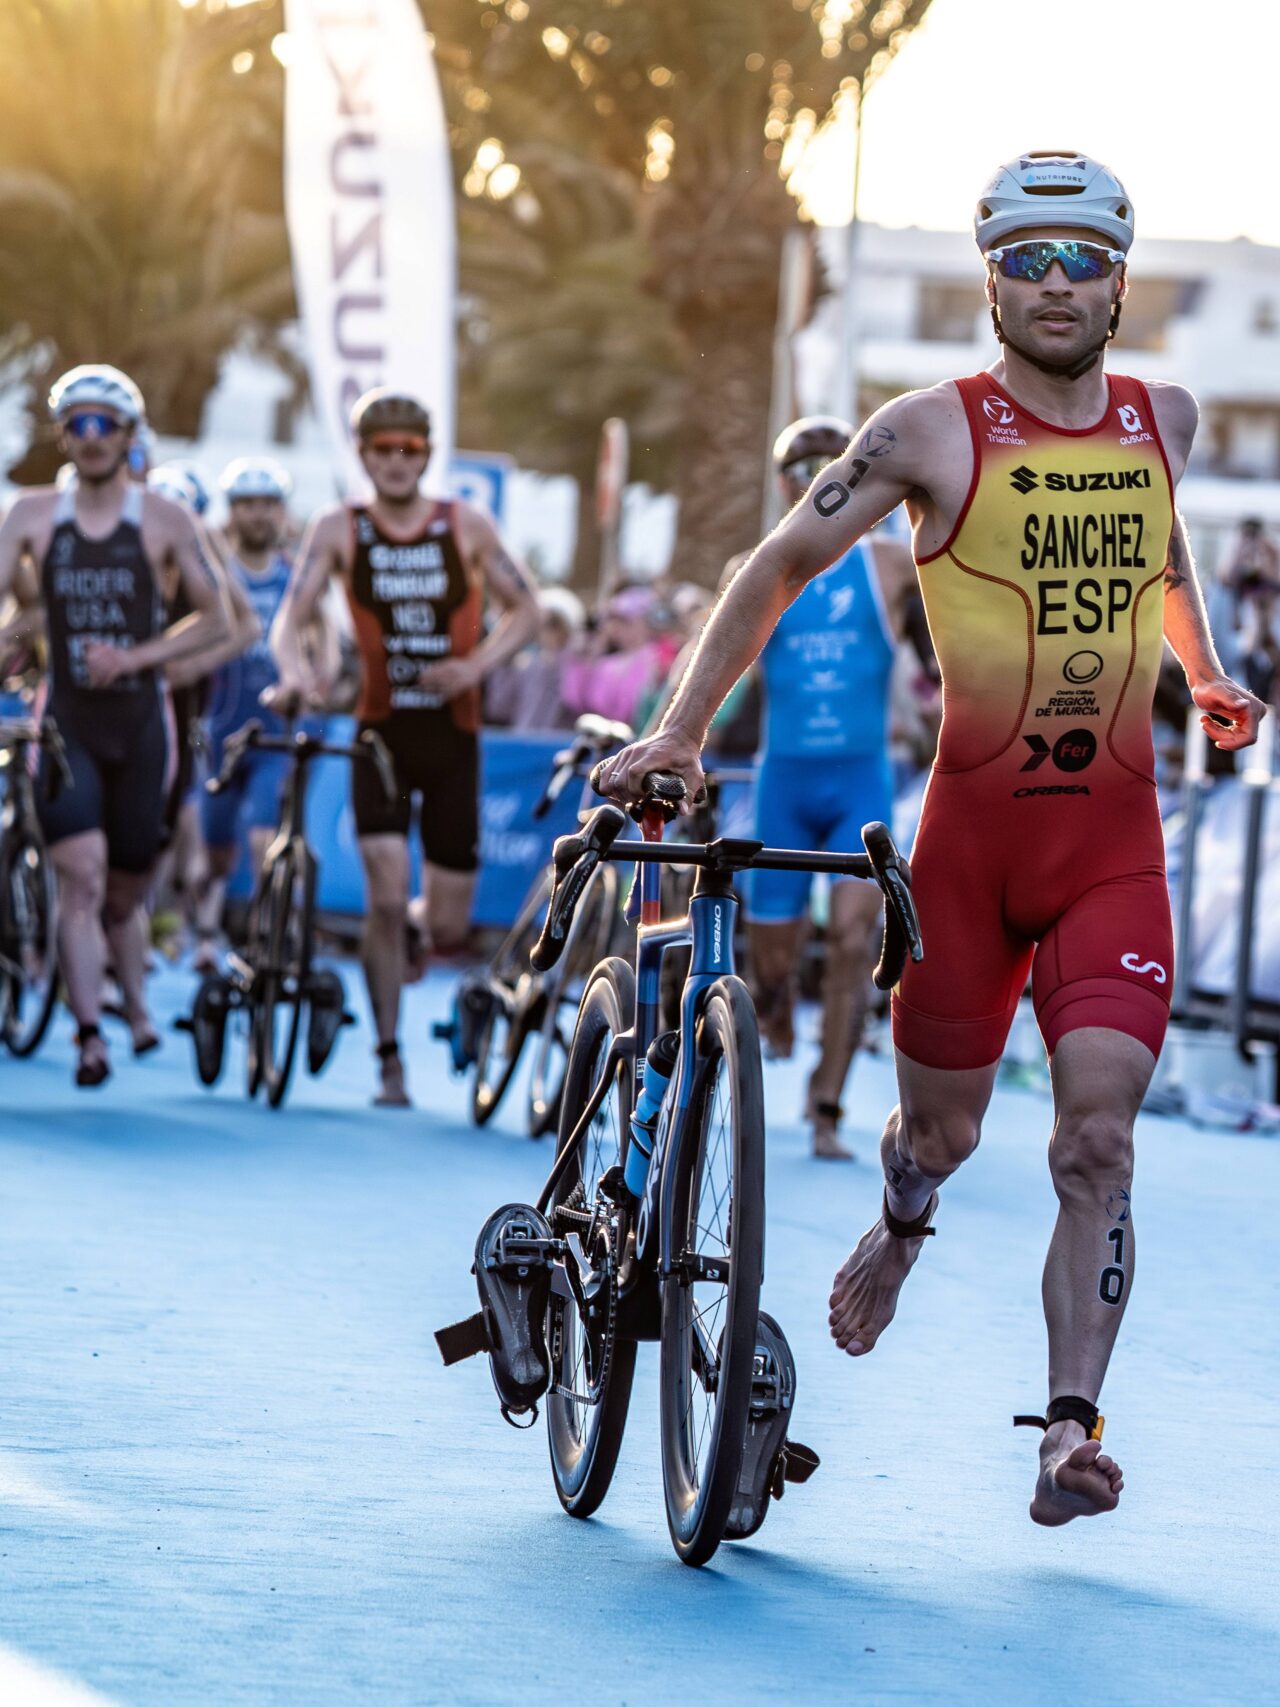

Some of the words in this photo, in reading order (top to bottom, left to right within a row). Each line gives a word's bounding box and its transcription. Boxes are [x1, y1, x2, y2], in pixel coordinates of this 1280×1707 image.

[1036, 174, 1083, 183] NUTRIPURE
[986, 433, 1027, 446] Triathlon
[990, 425, 1019, 437] World
[1044, 468, 1152, 493] SUZUKI
[1021, 513, 1146, 570] SANCHEZ
[54, 569, 136, 599] RIDER
[66, 600, 127, 630] USA
[1037, 578, 1132, 635] ESP
[1035, 708, 1052, 717] DE
[1055, 706, 1100, 716] MURCIA
[1048, 696, 1096, 706] REGIÓN
[1060, 742, 1089, 758] Fer
[1013, 784, 1091, 798] ORBEA
[713, 904, 722, 964] ORBEA
[636, 1062, 678, 1261] ORBE
[1098, 1226, 1125, 1307] 10
